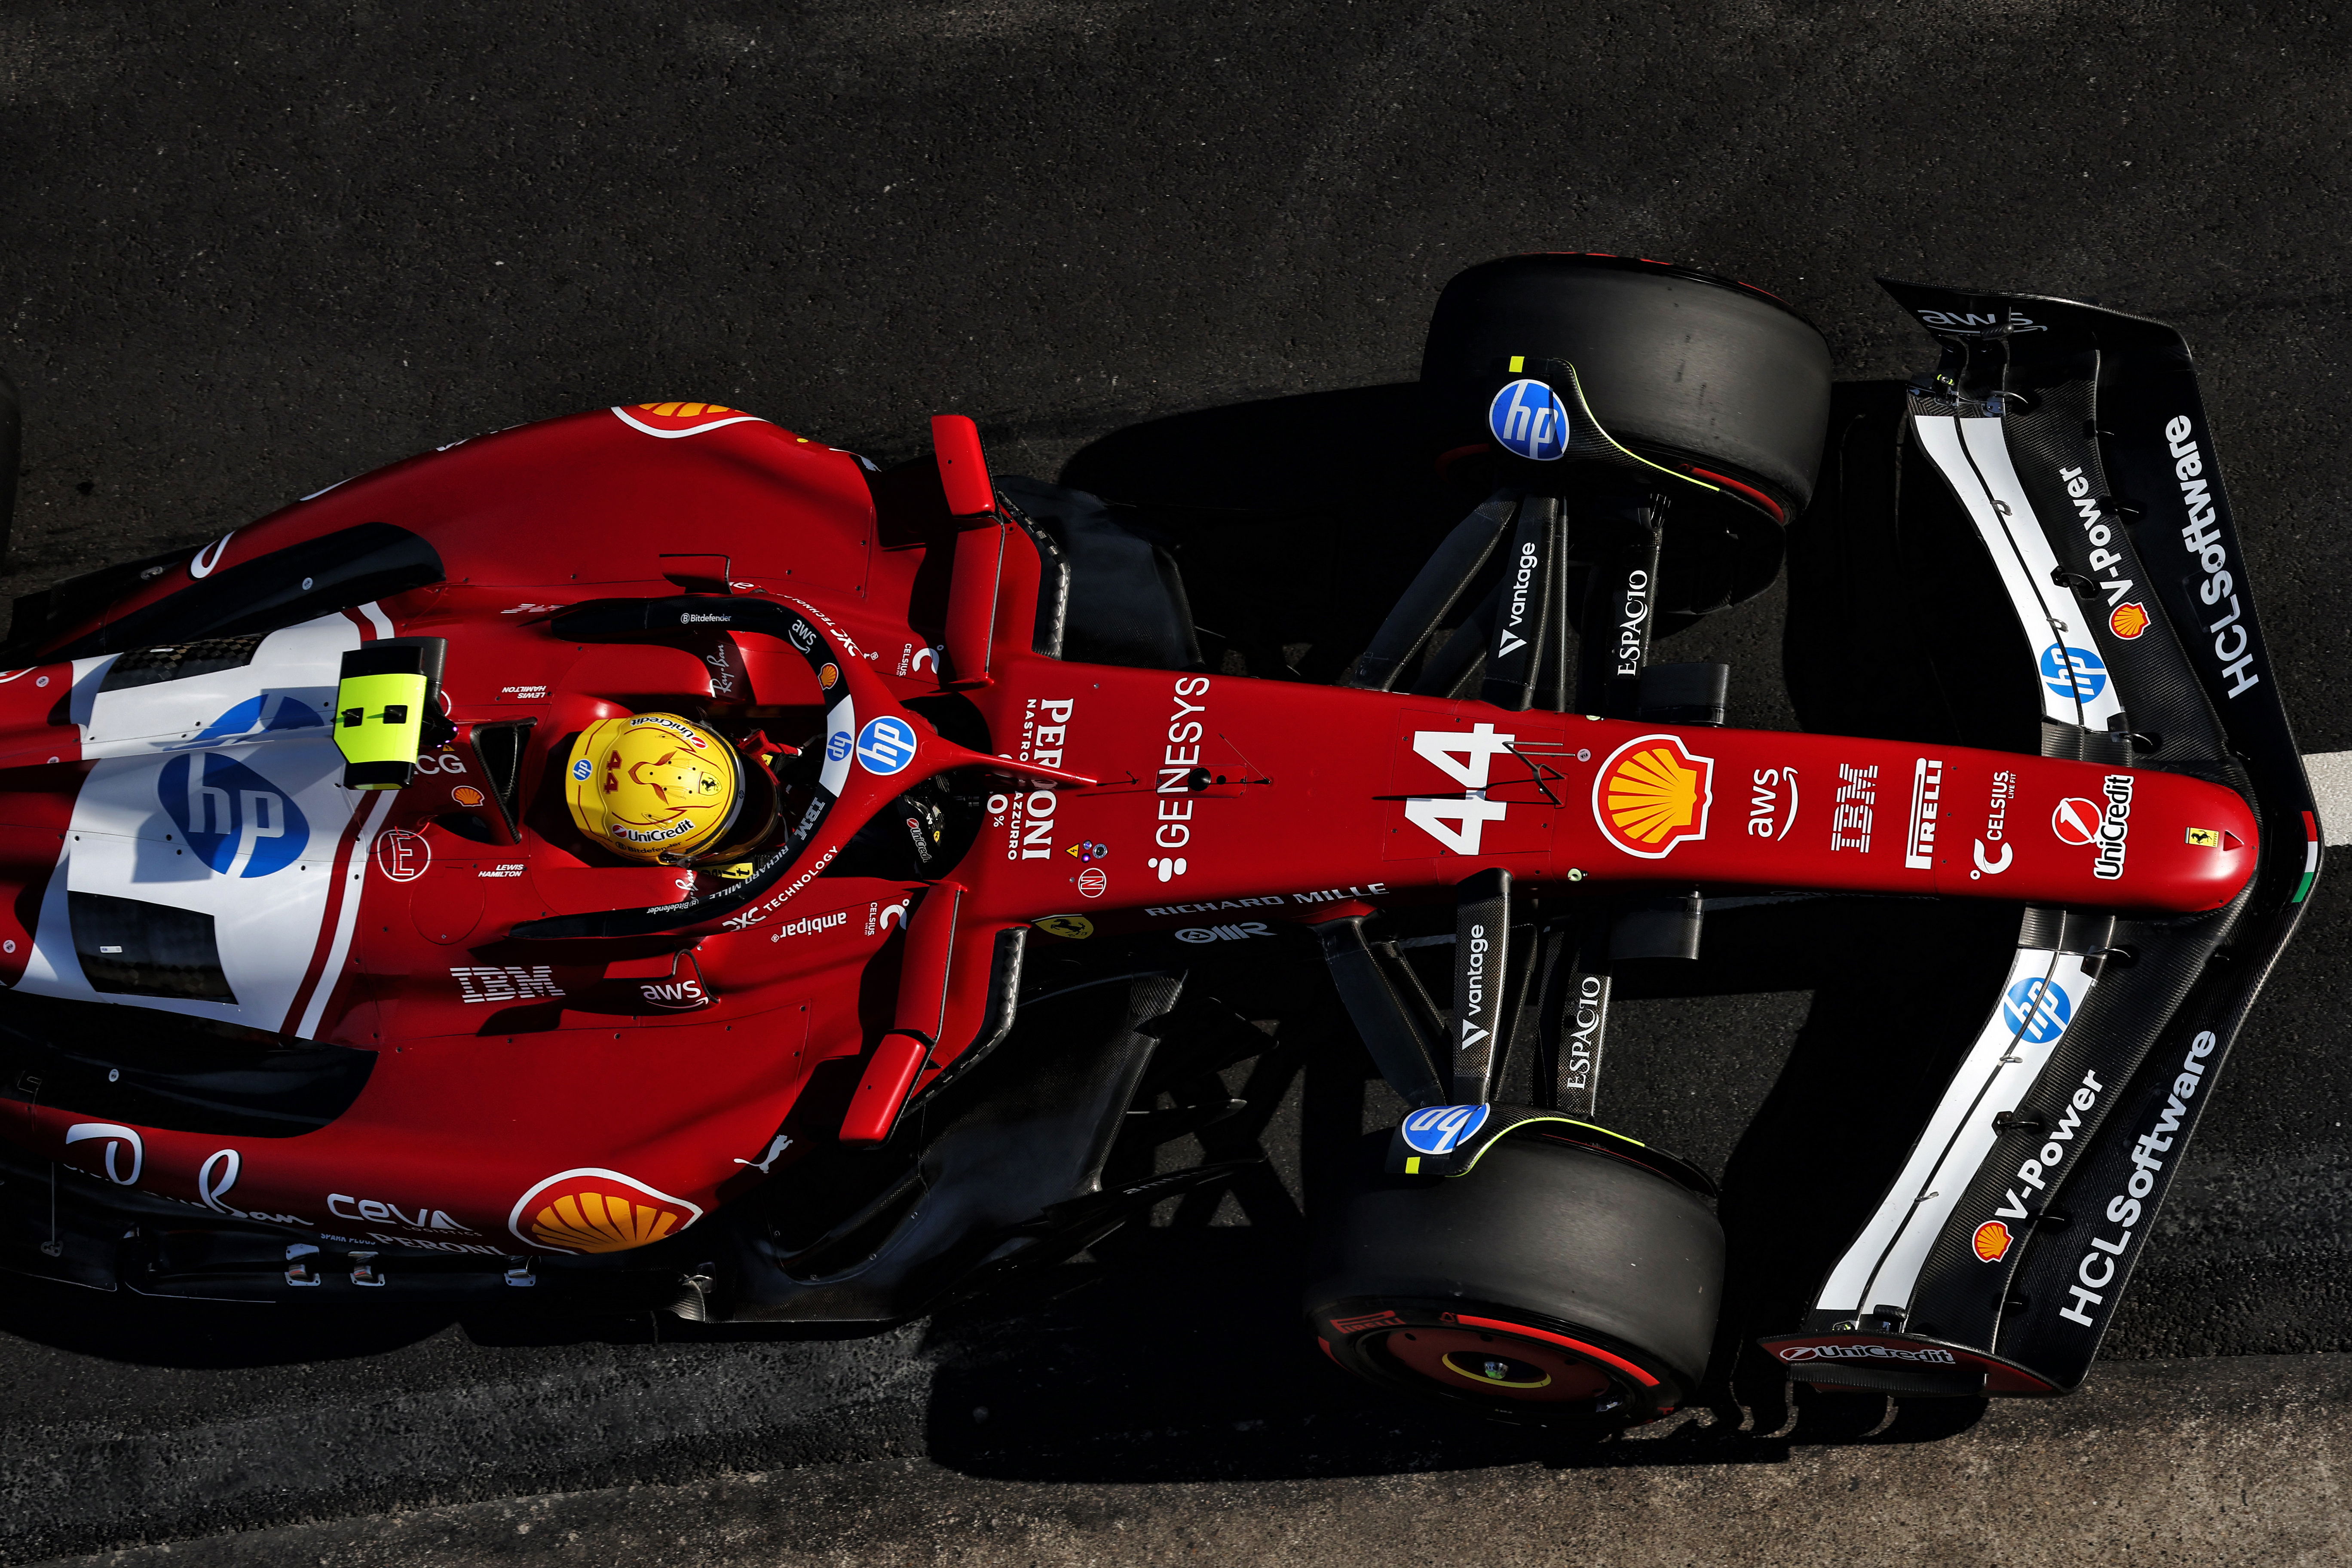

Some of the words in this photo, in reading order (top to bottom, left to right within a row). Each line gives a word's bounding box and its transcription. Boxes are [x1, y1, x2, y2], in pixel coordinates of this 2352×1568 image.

[1498, 380, 1564, 460] hp
[2059, 466, 2133, 606] V-Power
[2165, 415, 2259, 699] HCLSoftware
[1509, 542, 1537, 627] vantage
[690, 614, 731, 622] Bitdefender
[792, 619, 816, 645] aws
[1617, 570, 1648, 676] ESPACIO
[2041, 645, 2106, 699] hp
[631, 717, 693, 738] UniCredit
[827, 732, 852, 761] hp
[858, 719, 916, 772] hp
[1019, 698, 1037, 762] NASTRO
[413, 754, 467, 774] CG
[573, 760, 592, 780] hp
[603, 750, 622, 794] 44
[1156, 677, 1210, 848] GENESYS
[1404, 723, 1515, 855] 44
[1748, 769, 1779, 837] aws
[1831, 763, 1878, 853] IBM
[176, 753, 294, 878] hp
[628, 819, 694, 842] UniCredit
[794, 796, 825, 841] IBM
[1905, 758, 1942, 870] PIRELLI
[2093, 775, 2135, 880] UniCredit
[628, 842, 681, 853] Bitdefender
[745, 845, 789, 884] RICHARD
[910, 828, 932, 863] UniCredi
[710, 882, 741, 899] MILLE
[763, 846, 838, 912] TECHNOLOGY
[1081, 876, 1104, 889] N
[1144, 896, 1284, 916] RICHARD
[1292, 883, 1389, 903] MILLE
[647, 903, 689, 914] Bitdefender
[781, 912, 846, 938] ambipar
[449, 966, 566, 1003] IBM
[640, 980, 701, 1001] aws
[1468, 924, 1488, 1015] vantage
[2004, 978, 2070, 1042] hp
[1567, 976, 1601, 1090] ESPACIO
[1406, 1104, 1483, 1155] hp
[1994, 1069, 2103, 1219] V-Power
[2059, 1031, 2216, 1327] HCLSoftware
[366, 1232, 507, 1256] PERONI
[402, 1226, 483, 1237] LOGISTICS
[1329, 1310, 1406, 1334] PIRELLI
[1816, 1345, 1955, 1364] UniCredit
